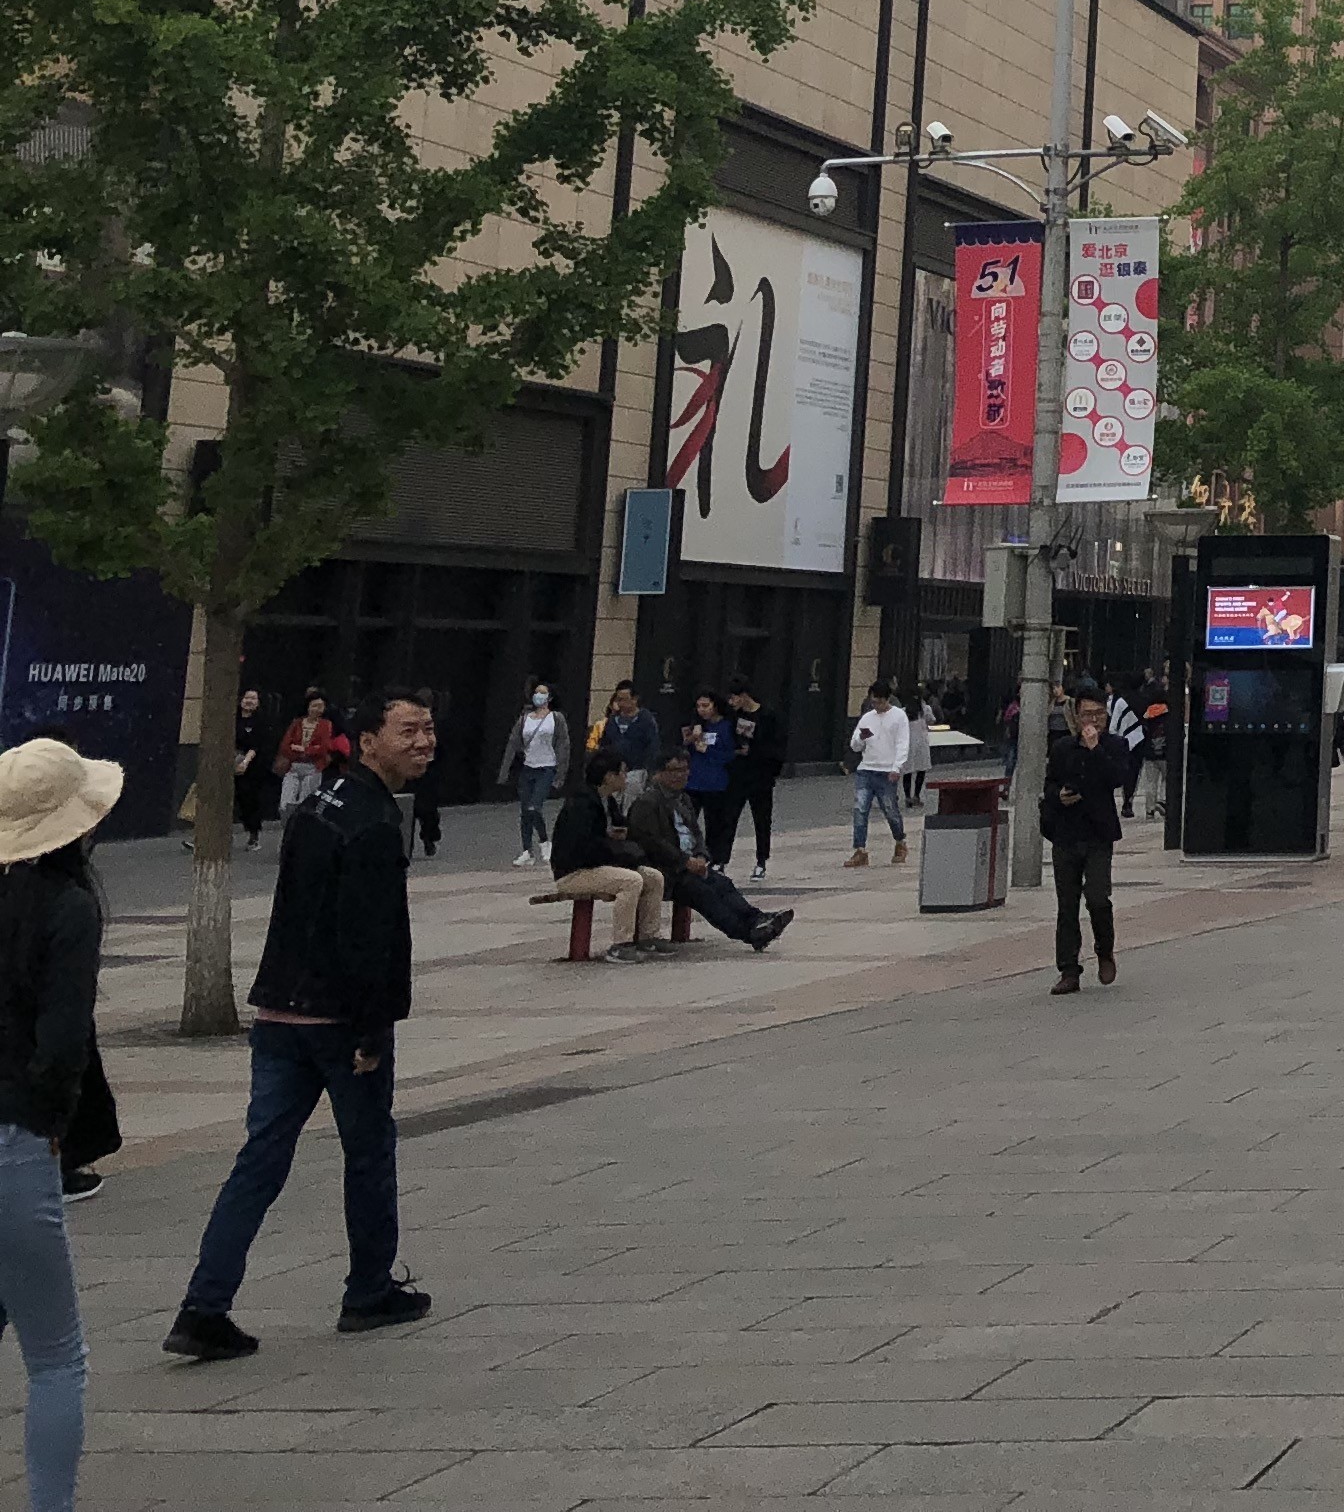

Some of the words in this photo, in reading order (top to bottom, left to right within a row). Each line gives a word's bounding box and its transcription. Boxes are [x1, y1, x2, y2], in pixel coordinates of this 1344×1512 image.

[1082, 243, 1128, 259] 爱北京
[975, 254, 1021, 292] 51
[1099, 261, 1147, 277] 逛银泰
[666, 232, 790, 519] 礼
[28, 663, 95, 683] HUAWEI
[98, 663, 147, 683] Mate20
